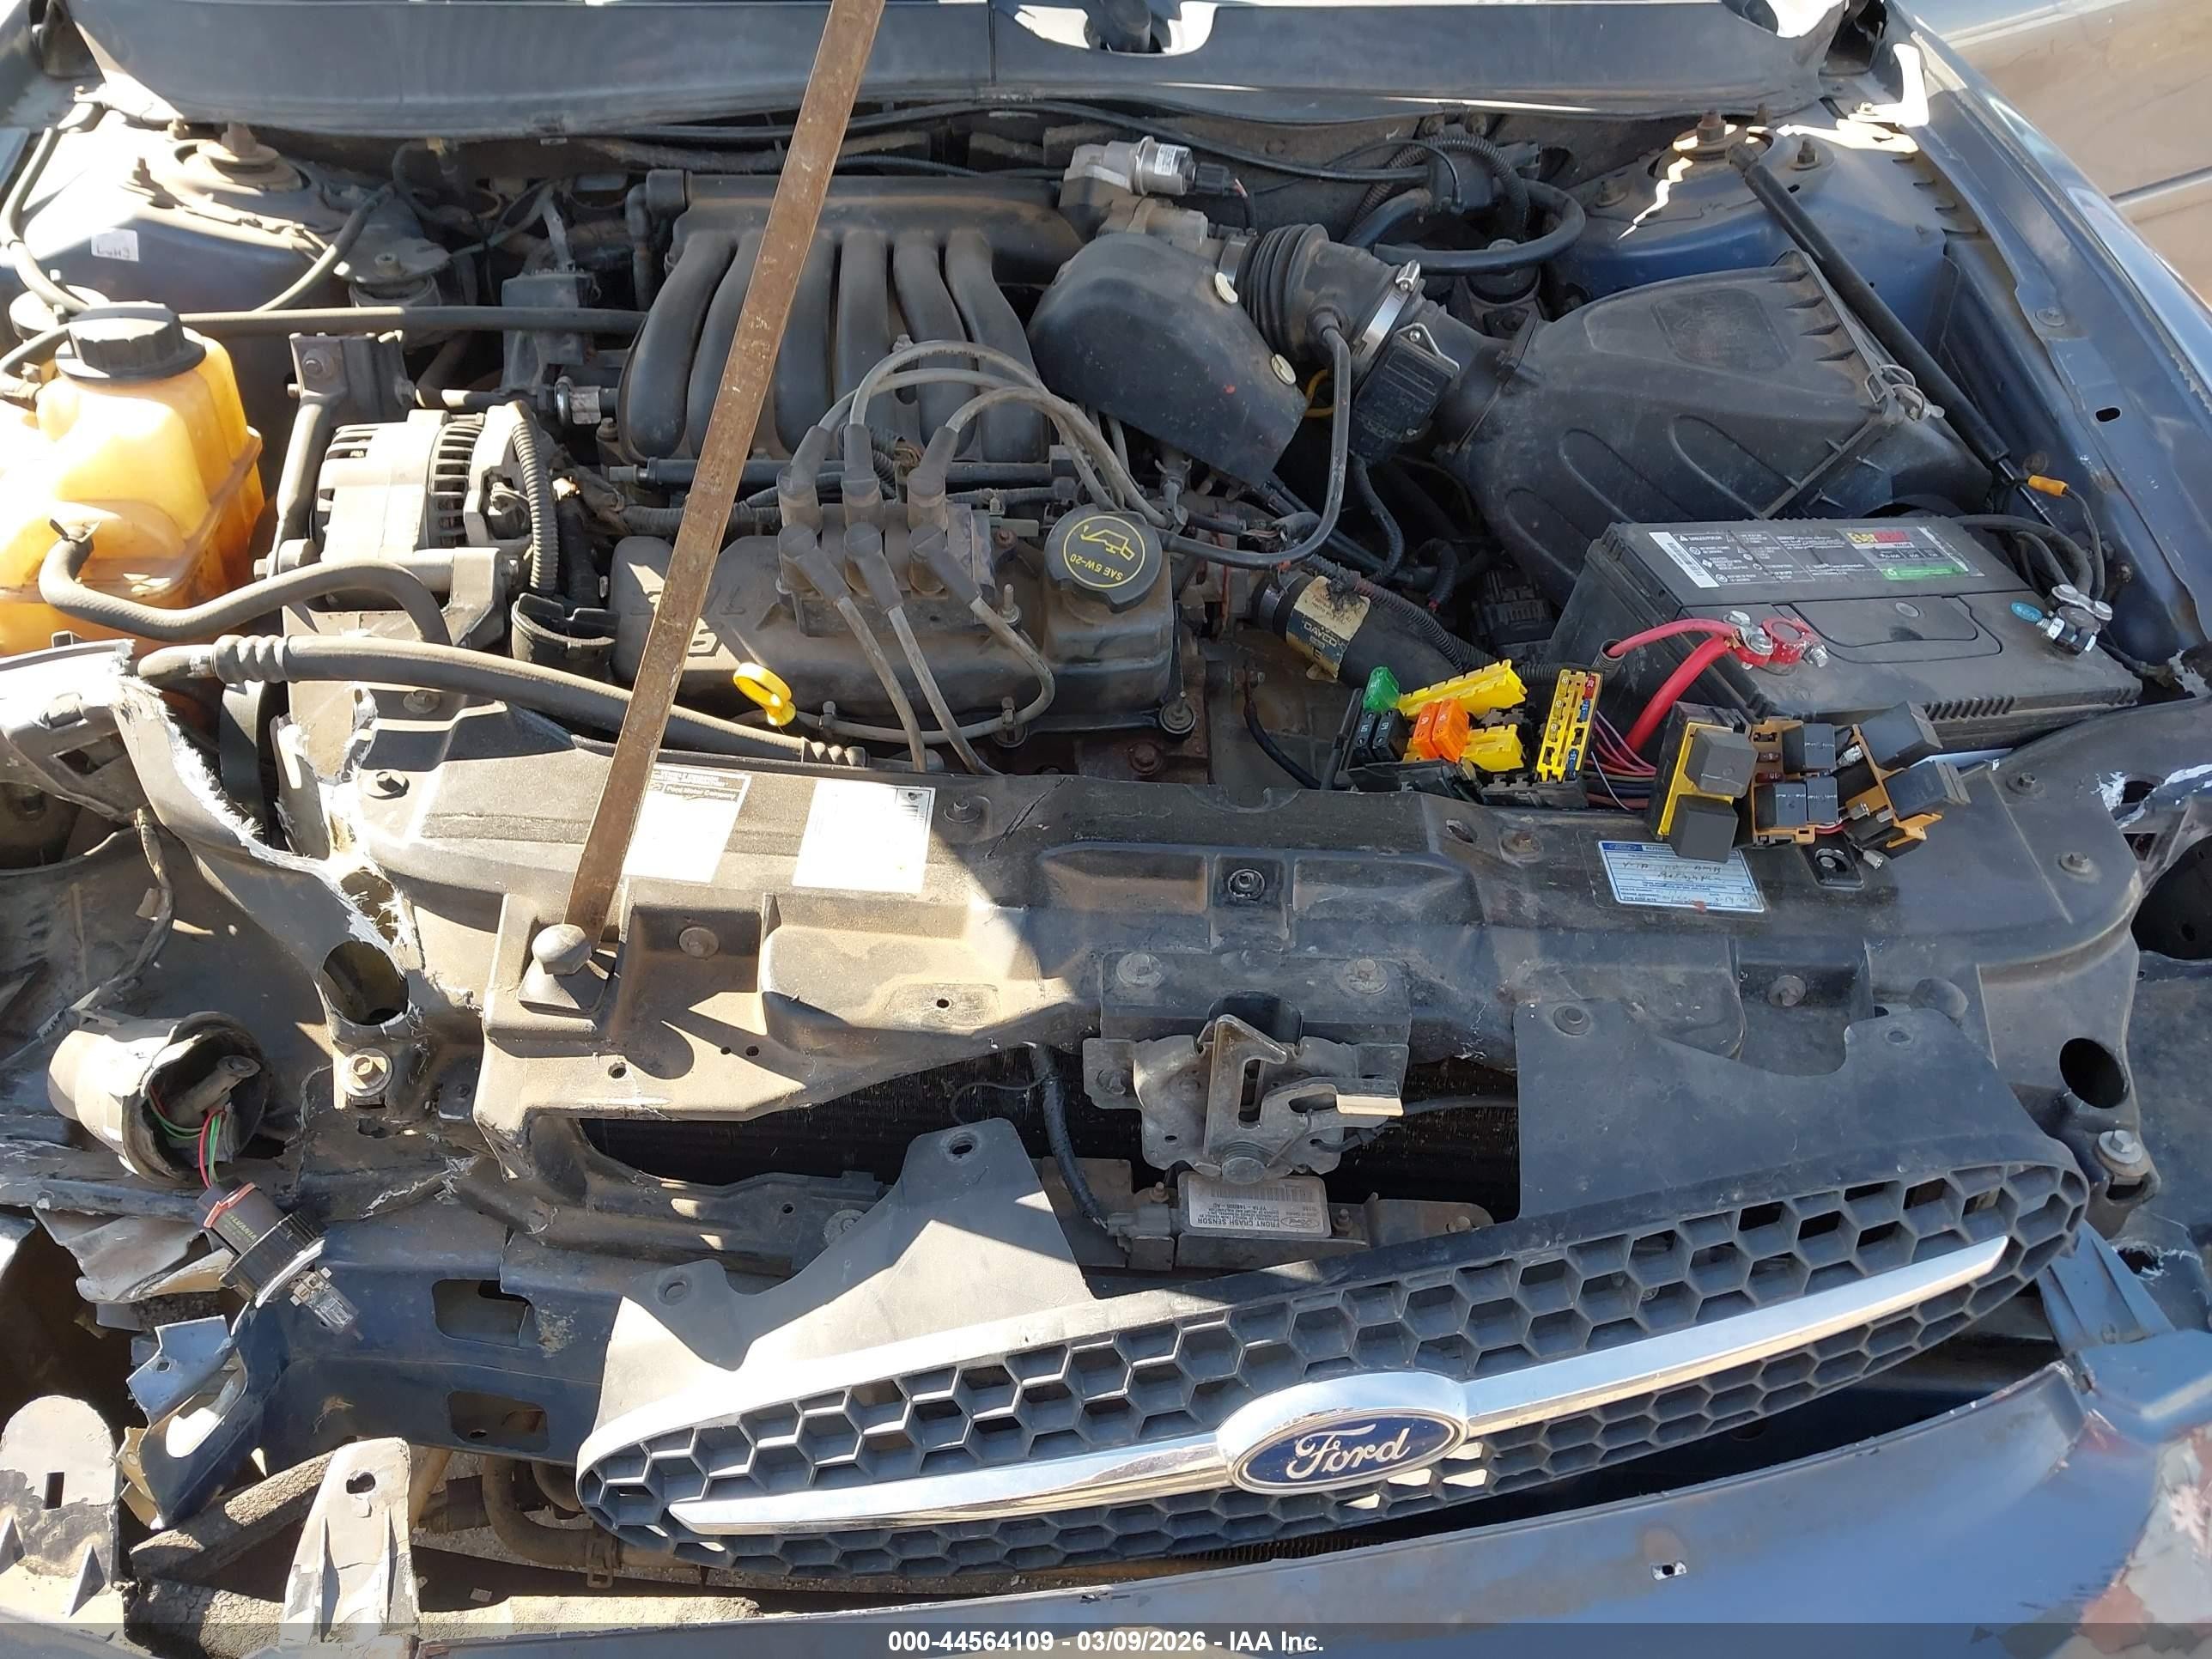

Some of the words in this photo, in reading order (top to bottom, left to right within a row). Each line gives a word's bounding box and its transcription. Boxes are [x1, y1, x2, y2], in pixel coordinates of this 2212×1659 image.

[1070, 554, 1103, 573] 5W-20
[1103, 567, 1124, 581] SAE
[1198, 1217, 1227, 1225] SENSOR
[1230, 1218, 1254, 1227] CRASH
[1256, 1219, 1279, 1228] FRONT
[1286, 1423, 1411, 1480] Ford
